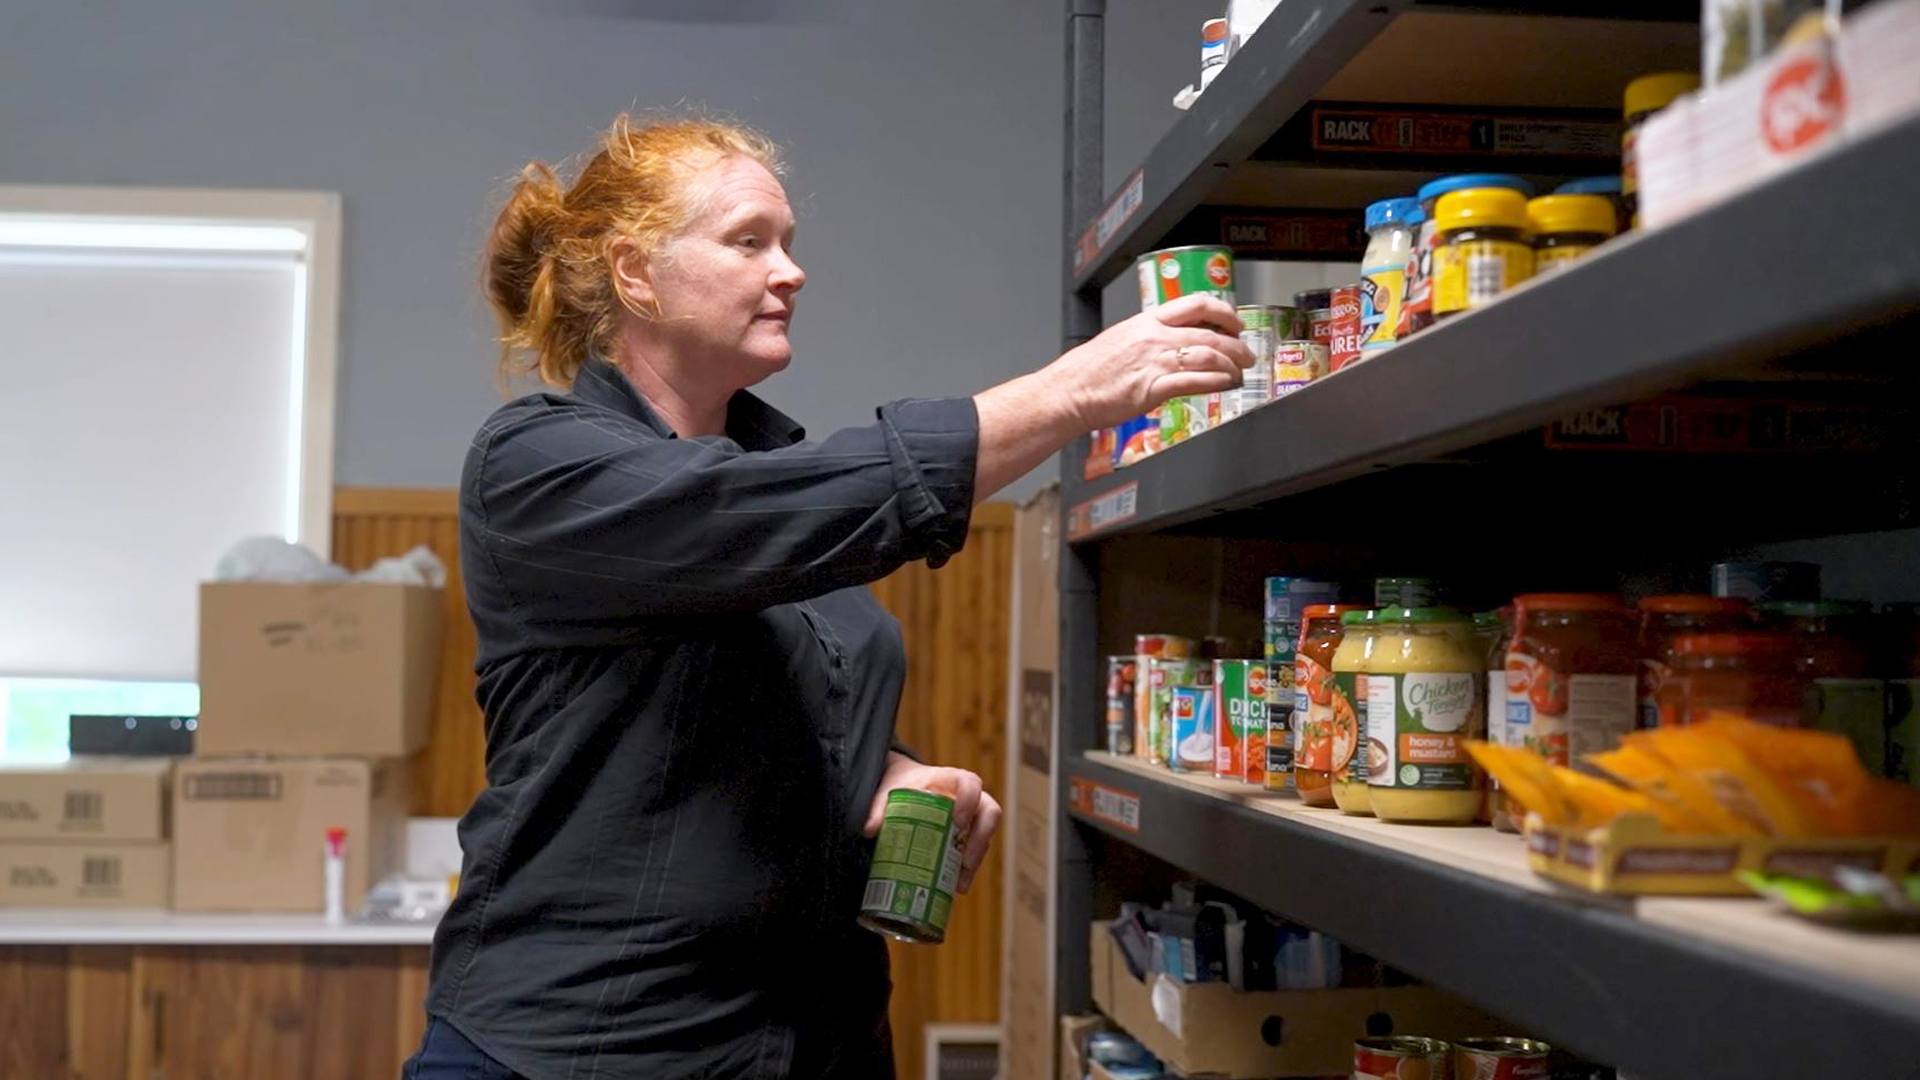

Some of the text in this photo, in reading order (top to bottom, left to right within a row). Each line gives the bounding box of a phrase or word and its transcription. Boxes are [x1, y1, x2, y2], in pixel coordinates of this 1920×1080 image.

[1324, 120, 1370, 140] RACK
[1229, 225, 1267, 241] RACK
[1409, 676, 1469, 706] Chicken
[1409, 736, 1444, 749] honey
[1409, 747, 1456, 759] mustard
